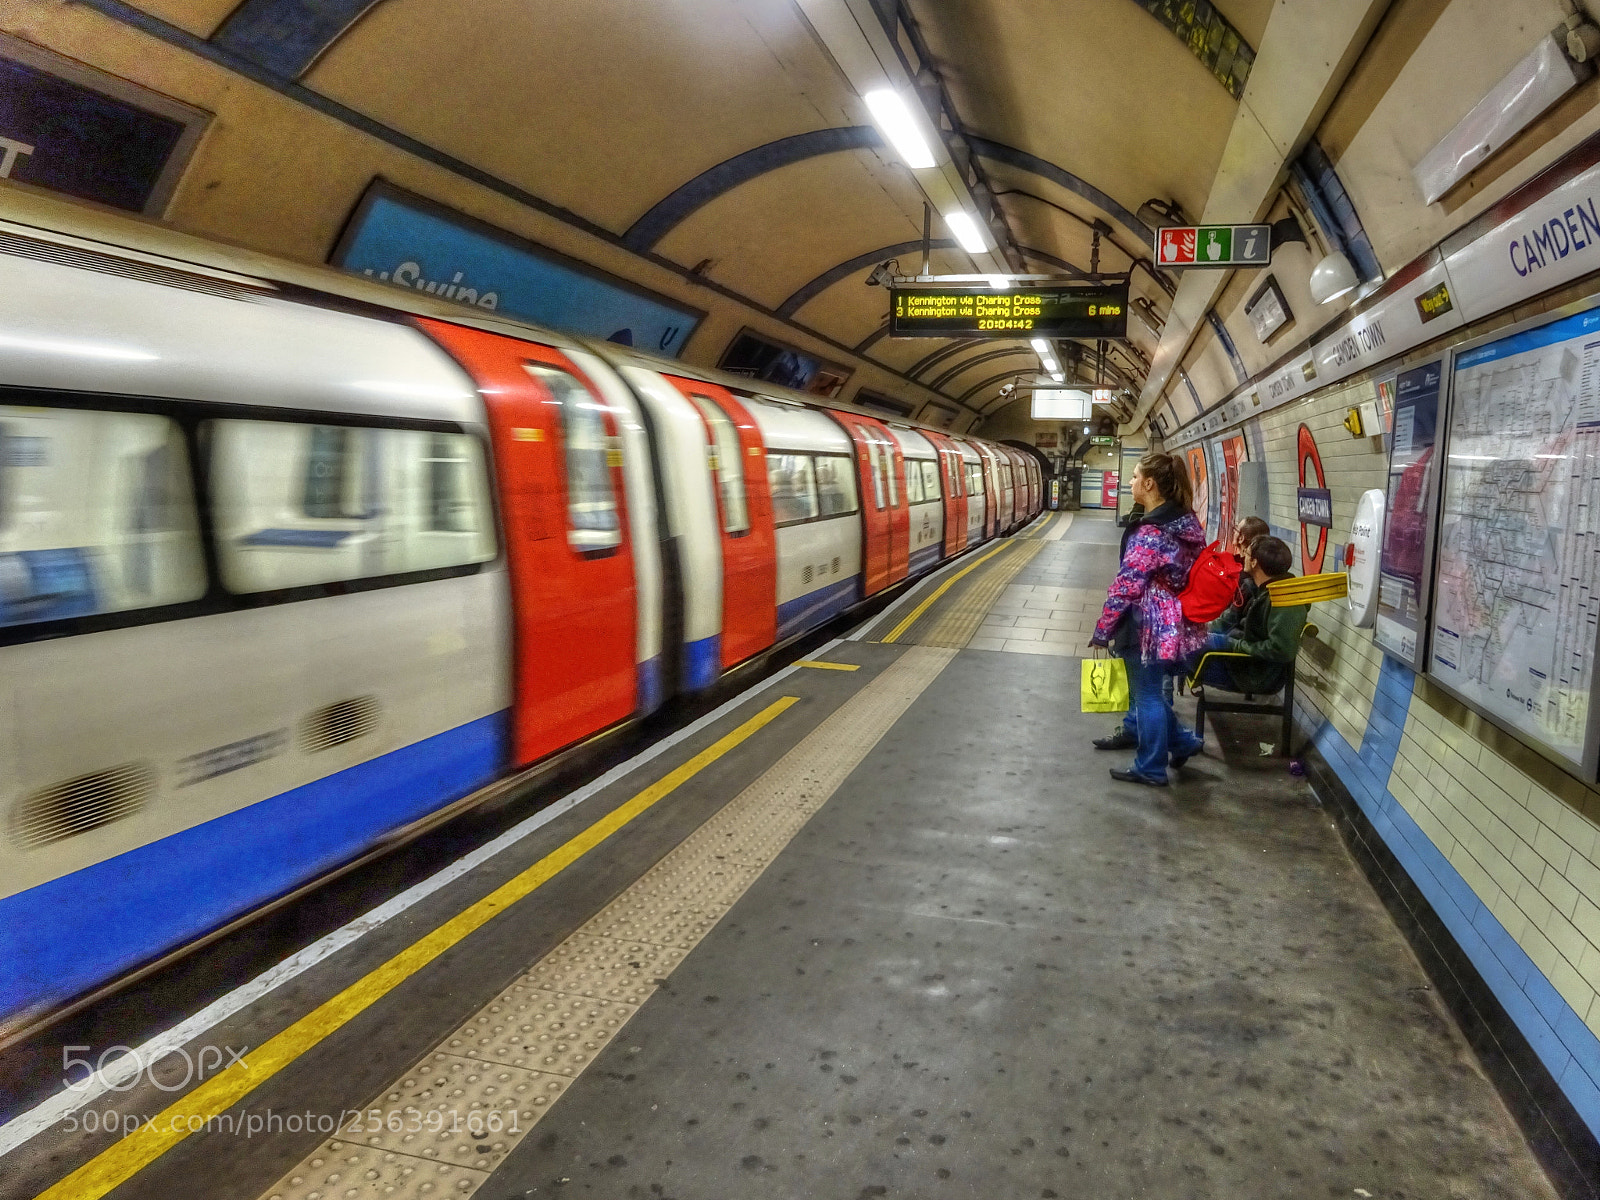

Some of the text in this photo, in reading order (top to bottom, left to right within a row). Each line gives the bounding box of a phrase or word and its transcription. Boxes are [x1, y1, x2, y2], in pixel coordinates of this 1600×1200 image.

[1509, 197, 1600, 277] CAMDEN
[898, 295, 1041, 307] 1 Kennington via Charing Cross
[896, 305, 1121, 317] 3 Kennington via Charing Cross 6 mins
[979, 320, 1033, 330] 20:04:42
[1332, 320, 1386, 367] CAMDEN TOWN
